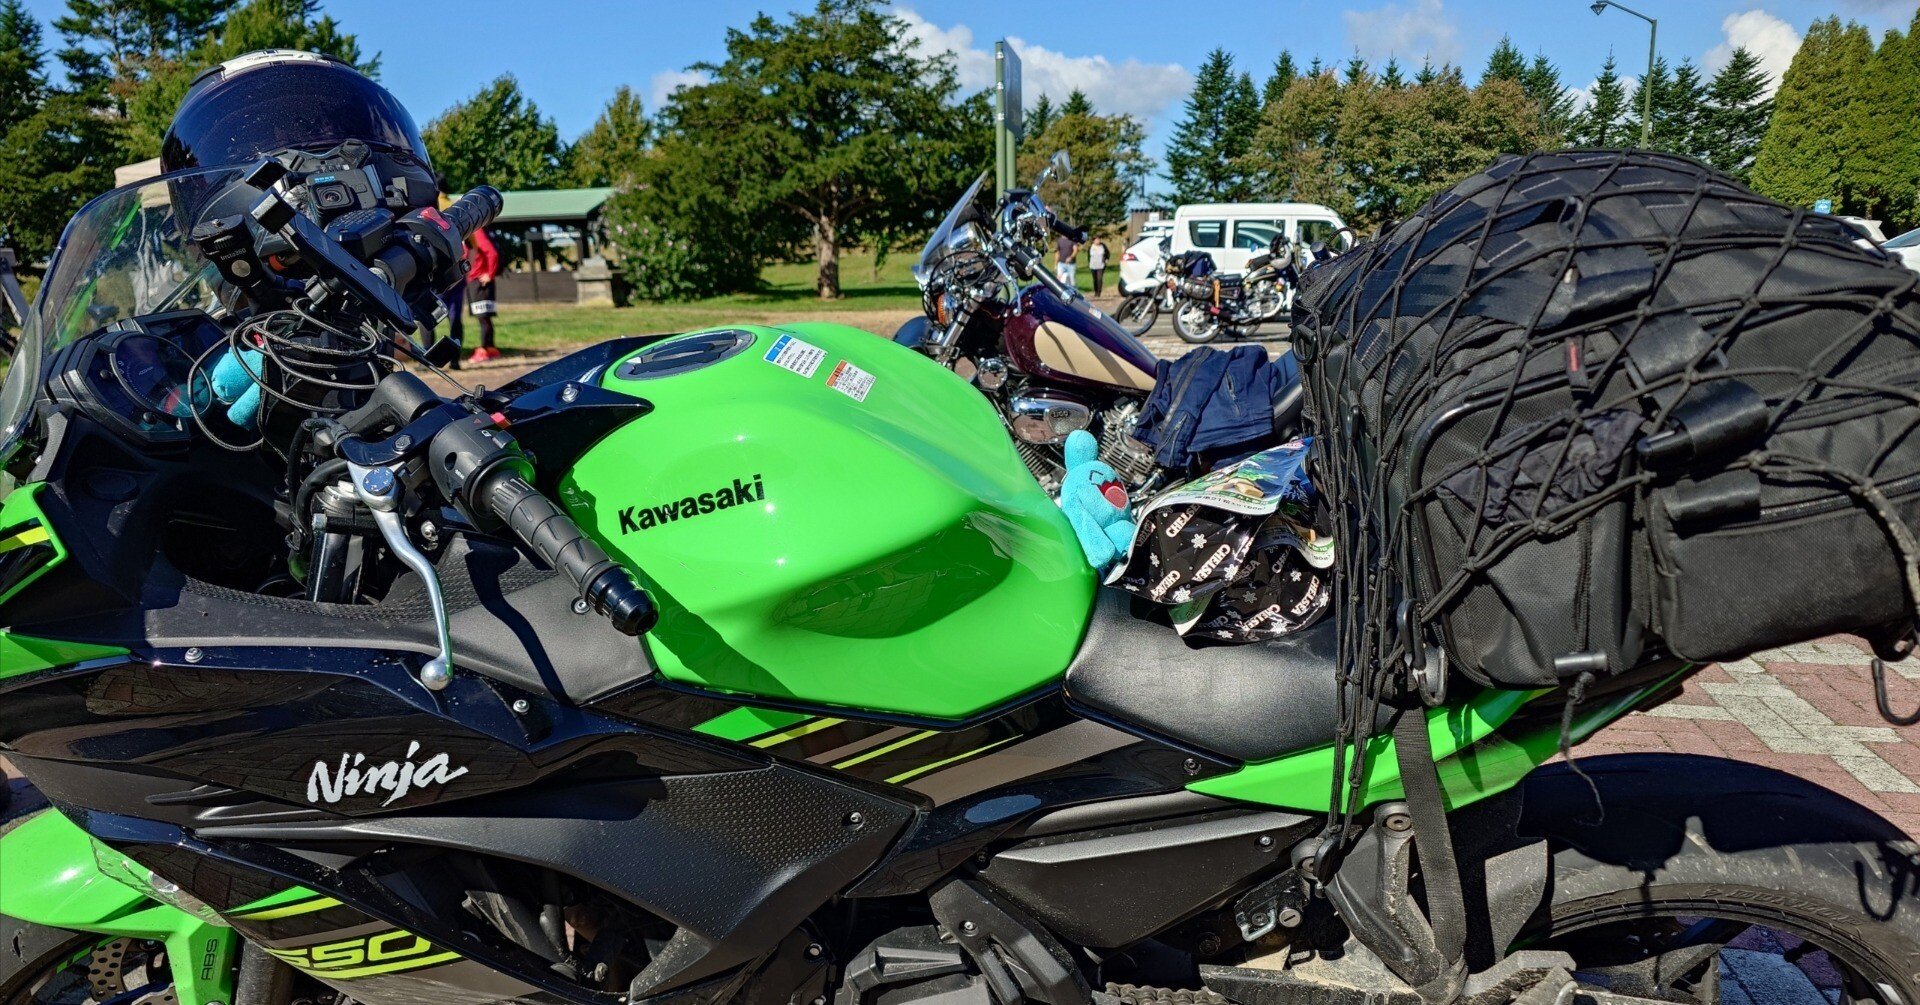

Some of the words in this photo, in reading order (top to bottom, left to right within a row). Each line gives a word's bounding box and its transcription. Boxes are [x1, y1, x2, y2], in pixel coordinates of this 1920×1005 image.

[220, 247, 247, 261] Insta360
[618, 474, 764, 535] Kawasaki
[1166, 503, 1201, 537] CHELSE
[1191, 544, 1231, 582] CHELSEA
[1291, 575, 1320, 617] CHELSEA
[1236, 603, 1281, 632] CHELSEA
[307, 740, 469, 807] Ninja
[201, 938, 218, 981] ABS
